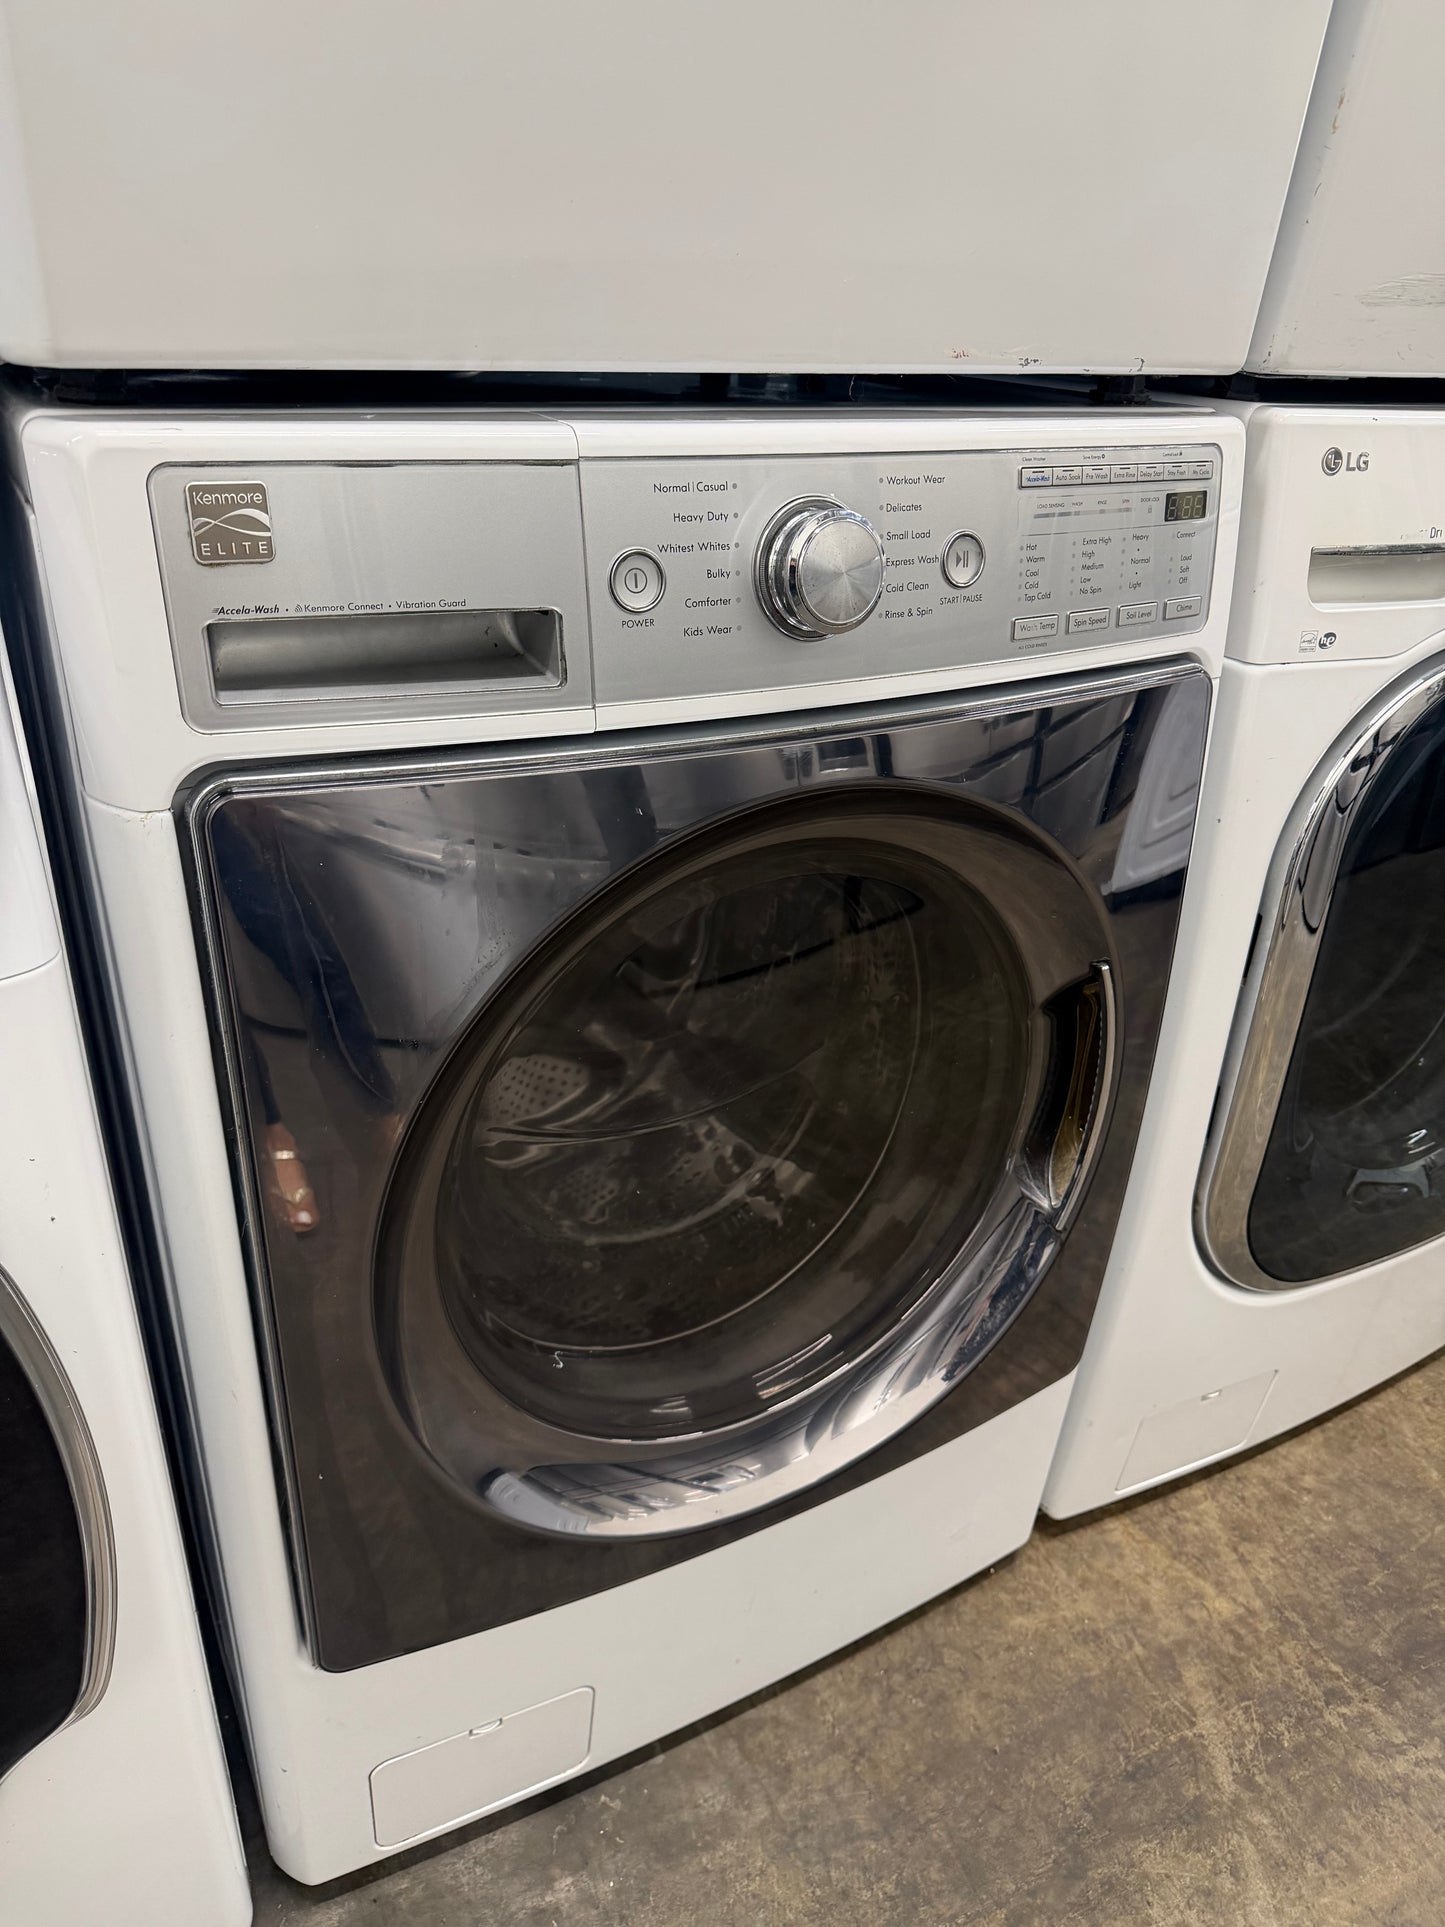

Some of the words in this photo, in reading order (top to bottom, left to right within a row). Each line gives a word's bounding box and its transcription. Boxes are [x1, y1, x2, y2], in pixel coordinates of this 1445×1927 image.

[1346, 452, 1370, 472] LG
[886, 474, 921, 486] Workout
[923, 473, 946, 485] Wear
[193, 490, 263, 506] Kenmore
[886, 501, 922, 513] Delicates
[673, 512, 704, 524] Heavy
[707, 510, 729, 523] Duty
[886, 529, 908, 541] Small
[911, 528, 931, 540] Load
[1132, 533, 1149, 541] Heavy
[1176, 531, 1196, 539] Connect
[1082, 538, 1097, 546] Extra
[1098, 536, 1112, 544] High
[201, 541, 269, 556] ELITE
[657, 541, 694, 554] Whitest
[698, 540, 731, 552] Whites
[1026, 543, 1037, 551] Hot
[1081, 550, 1095, 559] High
[886, 556, 915, 569] Express
[917, 554, 940, 566] Wash
[1130, 556, 1151, 565] Normal
[1081, 562, 1104, 571] Medium
[707, 568, 731, 581] Bulky
[1025, 569, 1040, 577] Cool
[886, 582, 904, 594] Cold
[907, 581, 929, 592] Clean
[1024, 581, 1039, 590] Cold
[1079, 587, 1088, 595] No
[1089, 586, 1102, 596] Spin
[1128, 581, 1142, 590] Light
[685, 596, 732, 609] Comforter
[1024, 594, 1036, 603] Tap
[1037, 592, 1051, 601] Cold
[217, 603, 280, 615] Accela-Wash
[304, 603, 345, 613] Kenmore
[347, 602, 384, 612] Connect
[396, 599, 436, 609] Vibration
[438, 598, 467, 608] Guard
[1176, 604, 1193, 612] Chime
[884, 609, 905, 620] Rinse
[907, 608, 914, 618] &
[916, 606, 933, 620] Spin
[1126, 612, 1136, 620] Soil
[1138, 610, 1152, 618] Level
[621, 618, 655, 629] POWER
[1039, 622, 1056, 632] Temp
[1073, 618, 1087, 628] Spin
[1088, 615, 1107, 625] Speed
[683, 626, 704, 638] Kids
[707, 624, 733, 636] Wear
